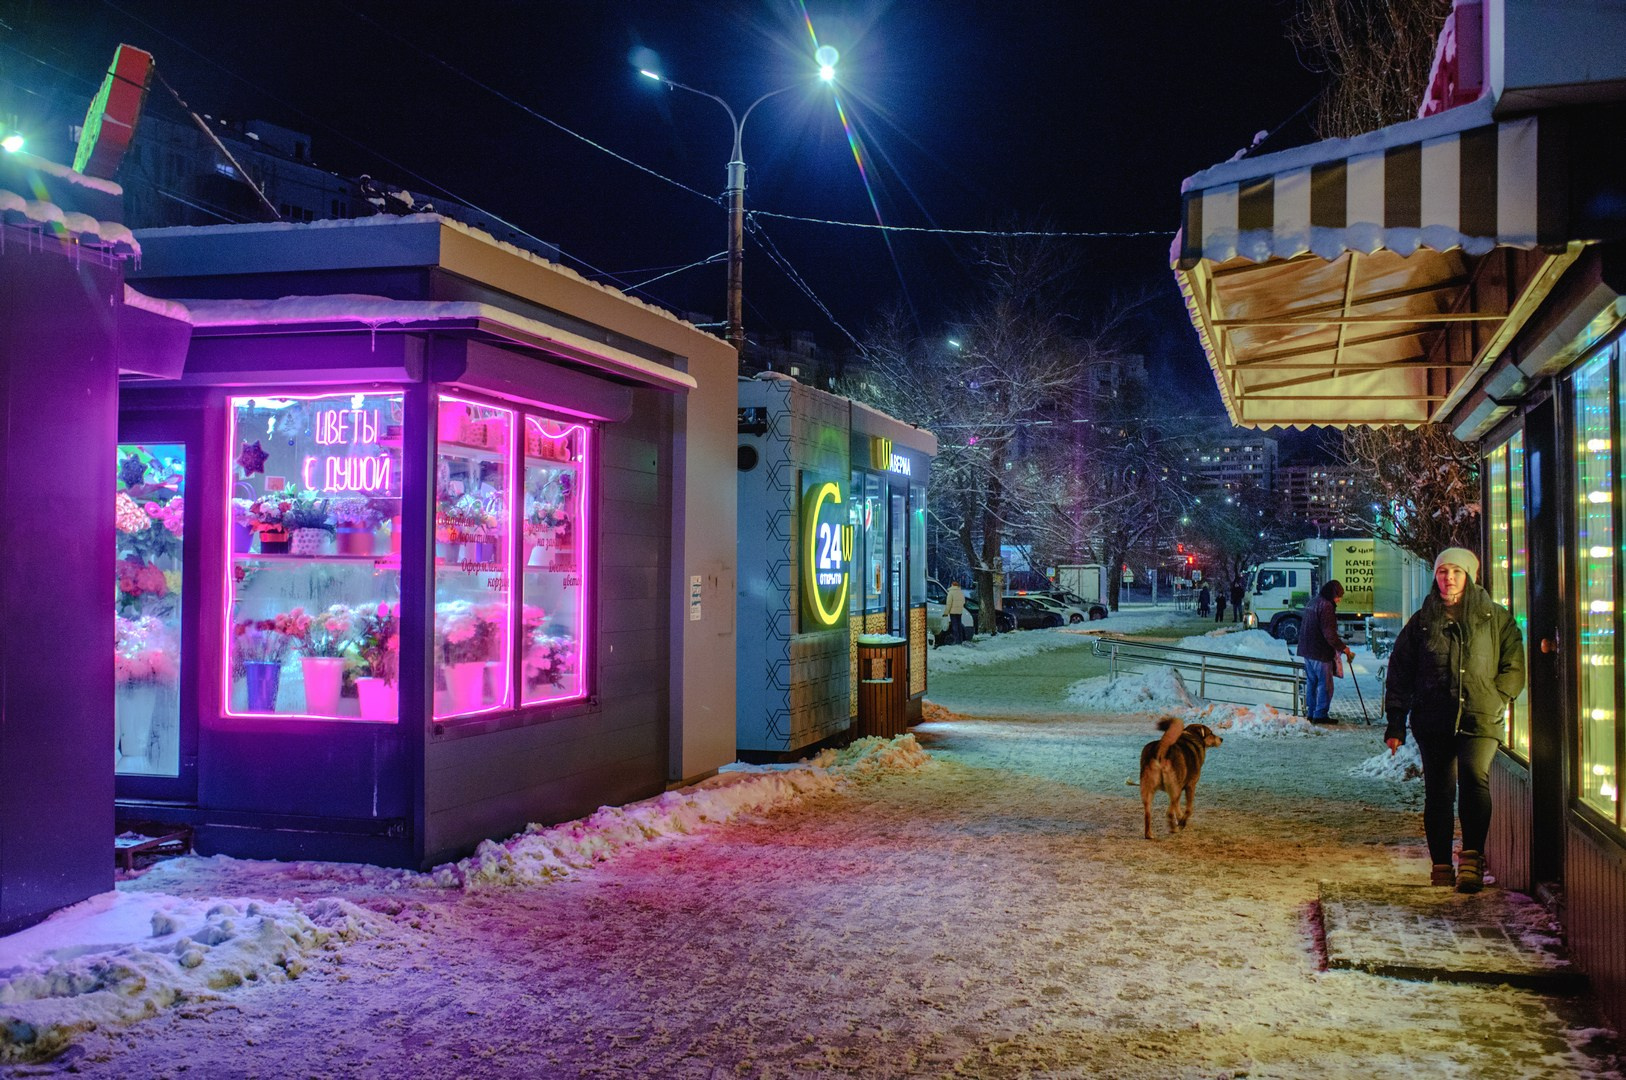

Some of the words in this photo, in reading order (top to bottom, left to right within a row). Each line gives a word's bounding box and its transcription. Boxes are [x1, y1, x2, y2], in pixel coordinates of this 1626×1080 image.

[315, 408, 378, 445] ЦВЕТЫ
[304, 457, 317, 490] С
[323, 453, 391, 492] ДУШОЙ
[820, 522, 842, 569] 24
[819, 572, 842, 585] ОТКРЫТО
